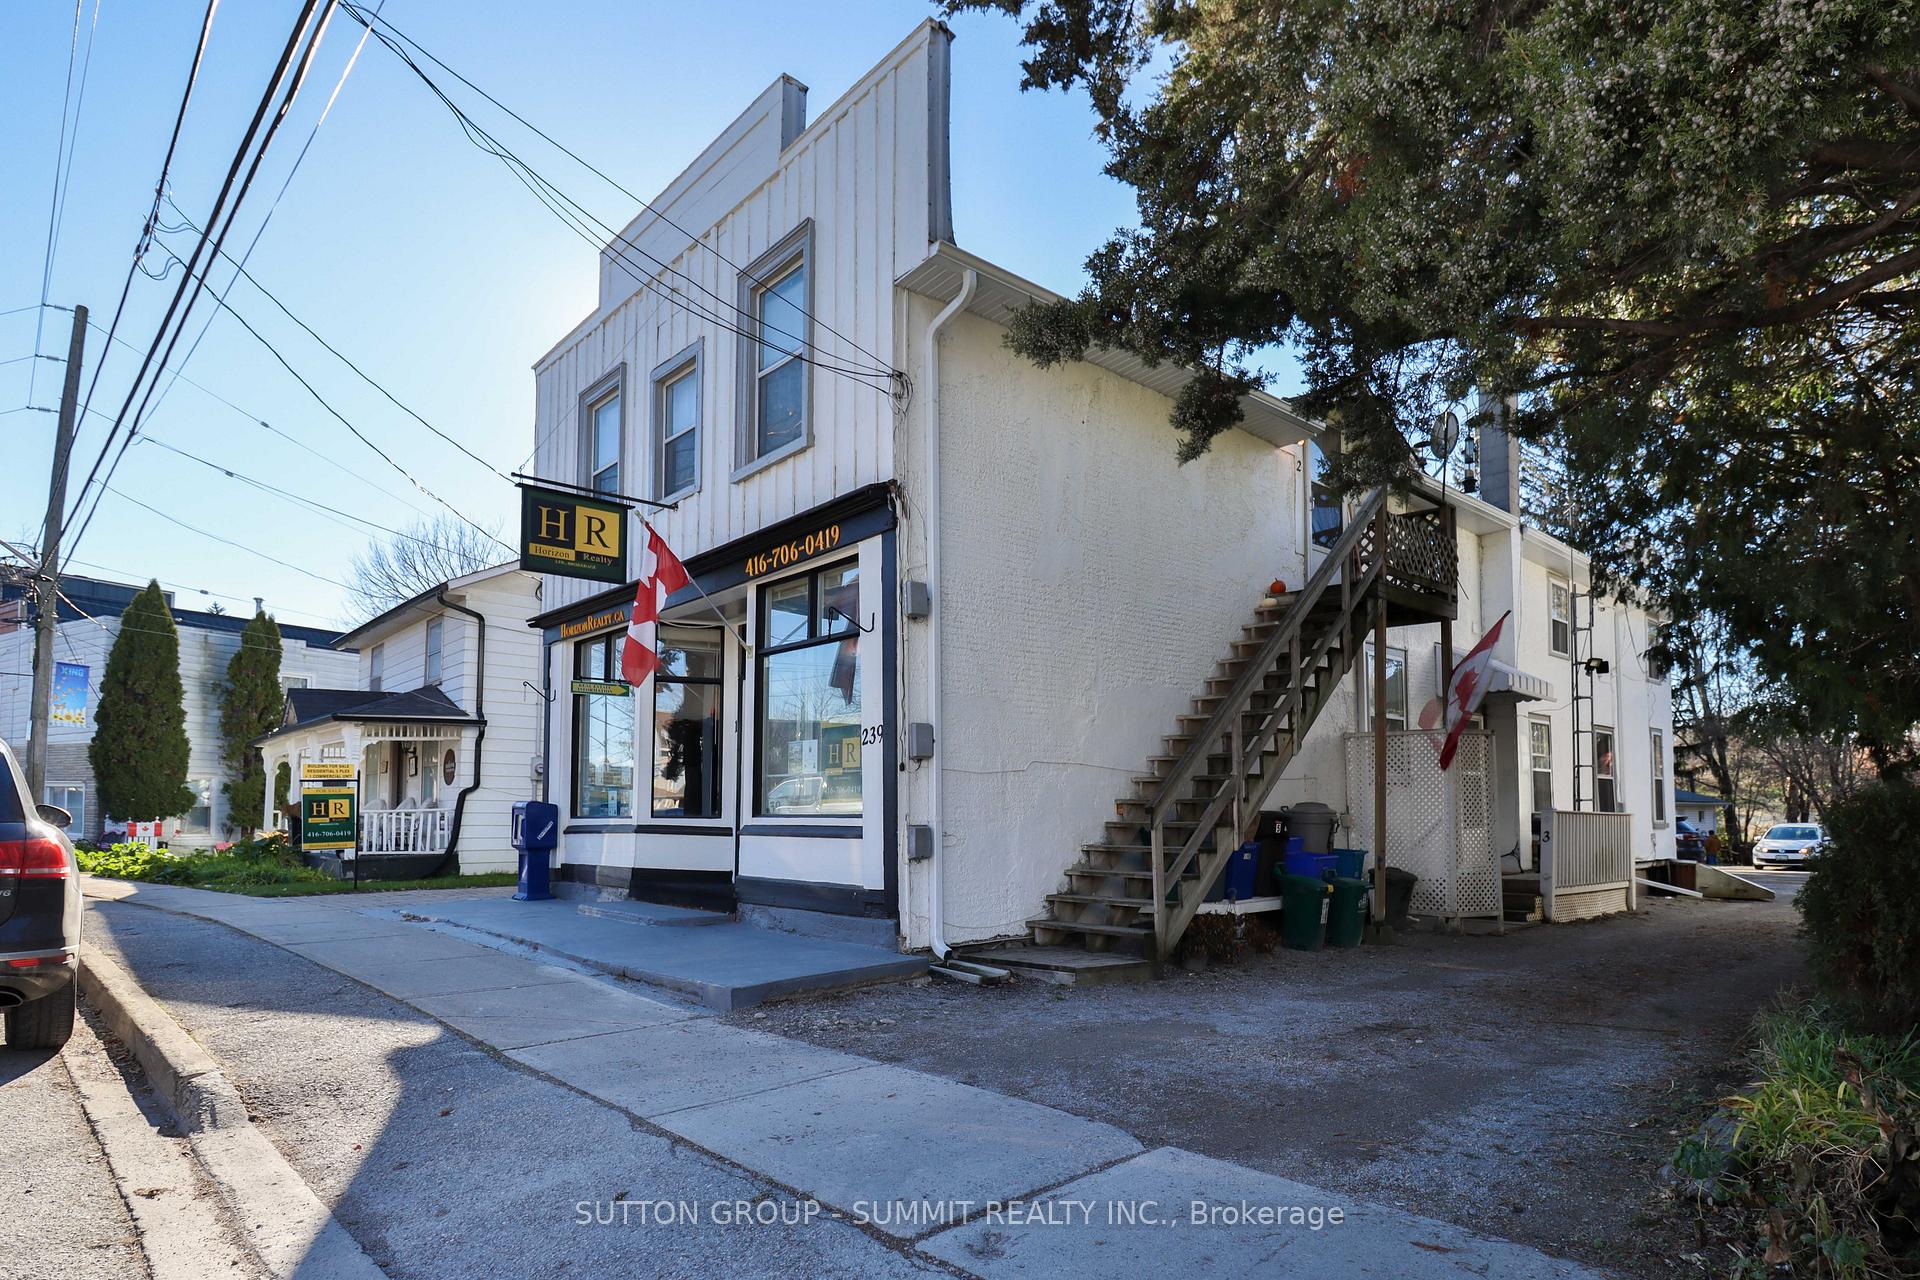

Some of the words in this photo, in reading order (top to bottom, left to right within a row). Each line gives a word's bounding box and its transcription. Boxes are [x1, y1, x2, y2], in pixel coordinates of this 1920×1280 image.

[1296, 460, 1302, 472] 2
[534, 545, 570, 559] Horizon
[583, 553, 613, 566] Realty
[745, 524, 840, 577] 416-706-0419
[861, 724, 884, 746] 239
[1541, 830, 1550, 843] 3
